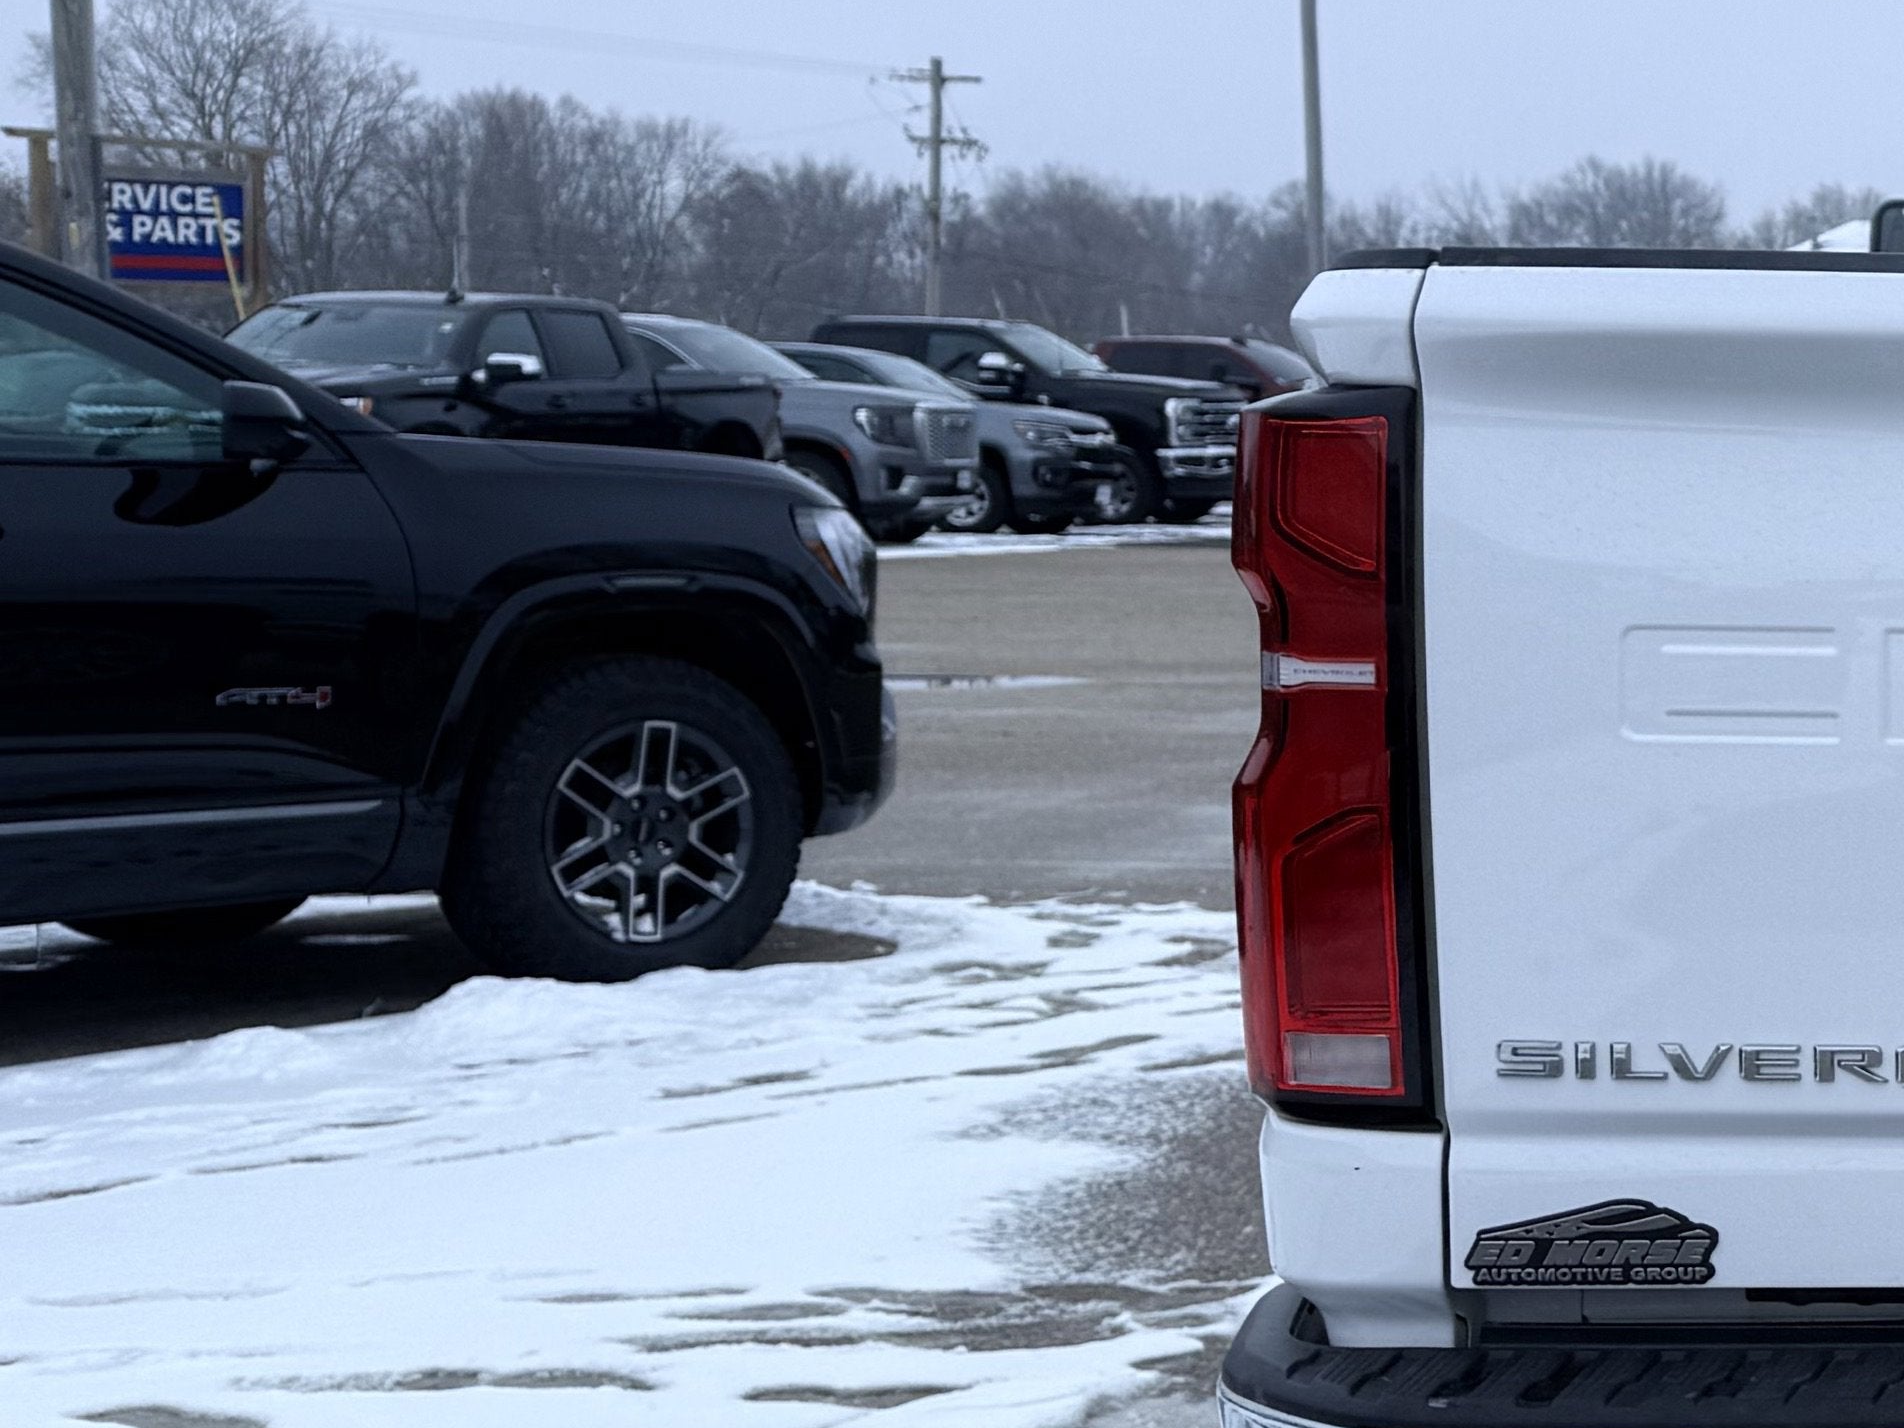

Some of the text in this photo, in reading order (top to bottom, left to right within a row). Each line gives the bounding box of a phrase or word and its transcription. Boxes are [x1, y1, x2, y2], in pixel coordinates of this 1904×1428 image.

[104, 181, 215, 215] RVICE
[131, 214, 241, 246] PARTS
[1467, 1239, 1711, 1266] ED MORSE
[1477, 1267, 1709, 1282] AUTOMOTIVE GROUP
